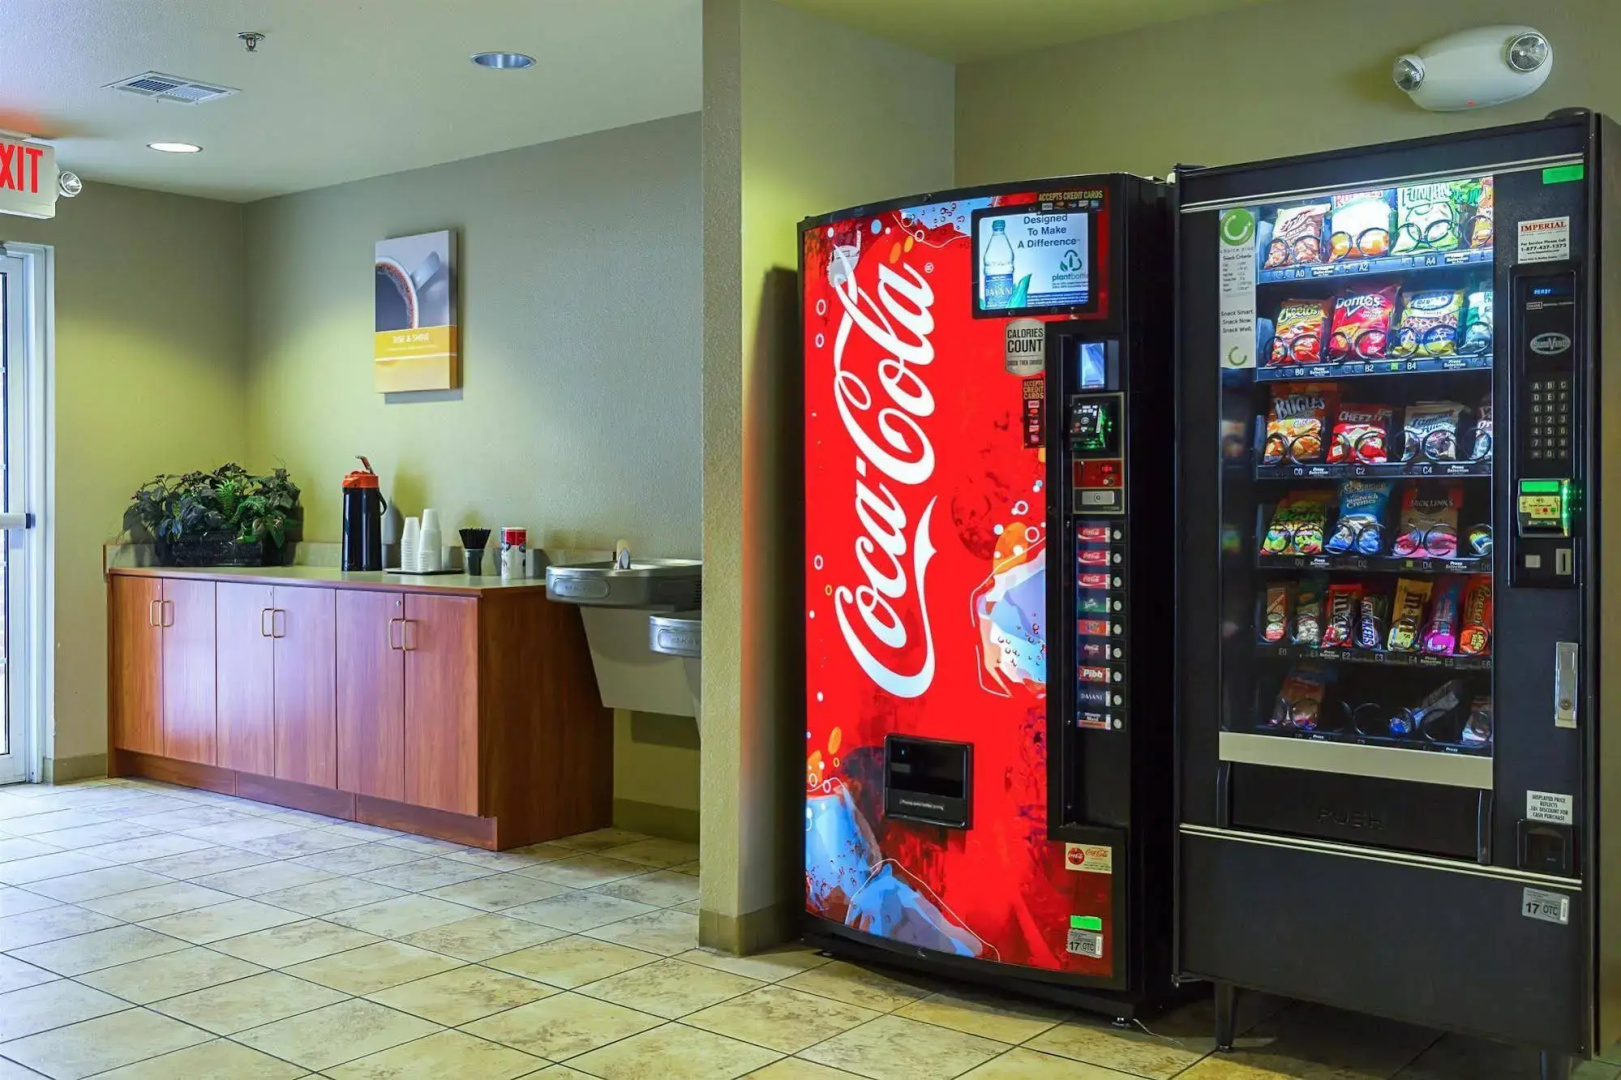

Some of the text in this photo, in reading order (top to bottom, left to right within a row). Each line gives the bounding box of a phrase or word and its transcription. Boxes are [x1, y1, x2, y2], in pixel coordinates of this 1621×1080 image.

[1038, 190, 1103, 201] ACCEPTS CREDIT CARDS
[1023, 214, 1068, 225] Designed
[1027, 225, 1067, 236] To Make
[1521, 221, 1566, 232] IMPERIAL
[1018, 241, 1024, 249] A
[1295, 269, 1305, 277] A0
[1007, 328, 1044, 339] CALORIES
[1007, 339, 1043, 353] COUNT
[1365, 364, 1374, 372] B2
[1407, 362, 1416, 370] B4
[1295, 368, 1304, 376] B0
[834, 243, 937, 698] Coca-Cola
[1356, 467, 1365, 475] C2
[1423, 466, 1432, 474] C4
[1423, 561, 1432, 569] D4
[1361, 602, 1376, 647] SNICKERS
[1342, 652, 1351, 660] E2
[1409, 656, 1417, 664] E4
[1445, 659, 1454, 667] E5
[1083, 669, 1103, 678] Pibb
[1081, 692, 1102, 700] DASANI
[1317, 807, 1385, 830] PUSH
[1525, 902, 1539, 914] 17
[1069, 941, 1080, 951] 17
